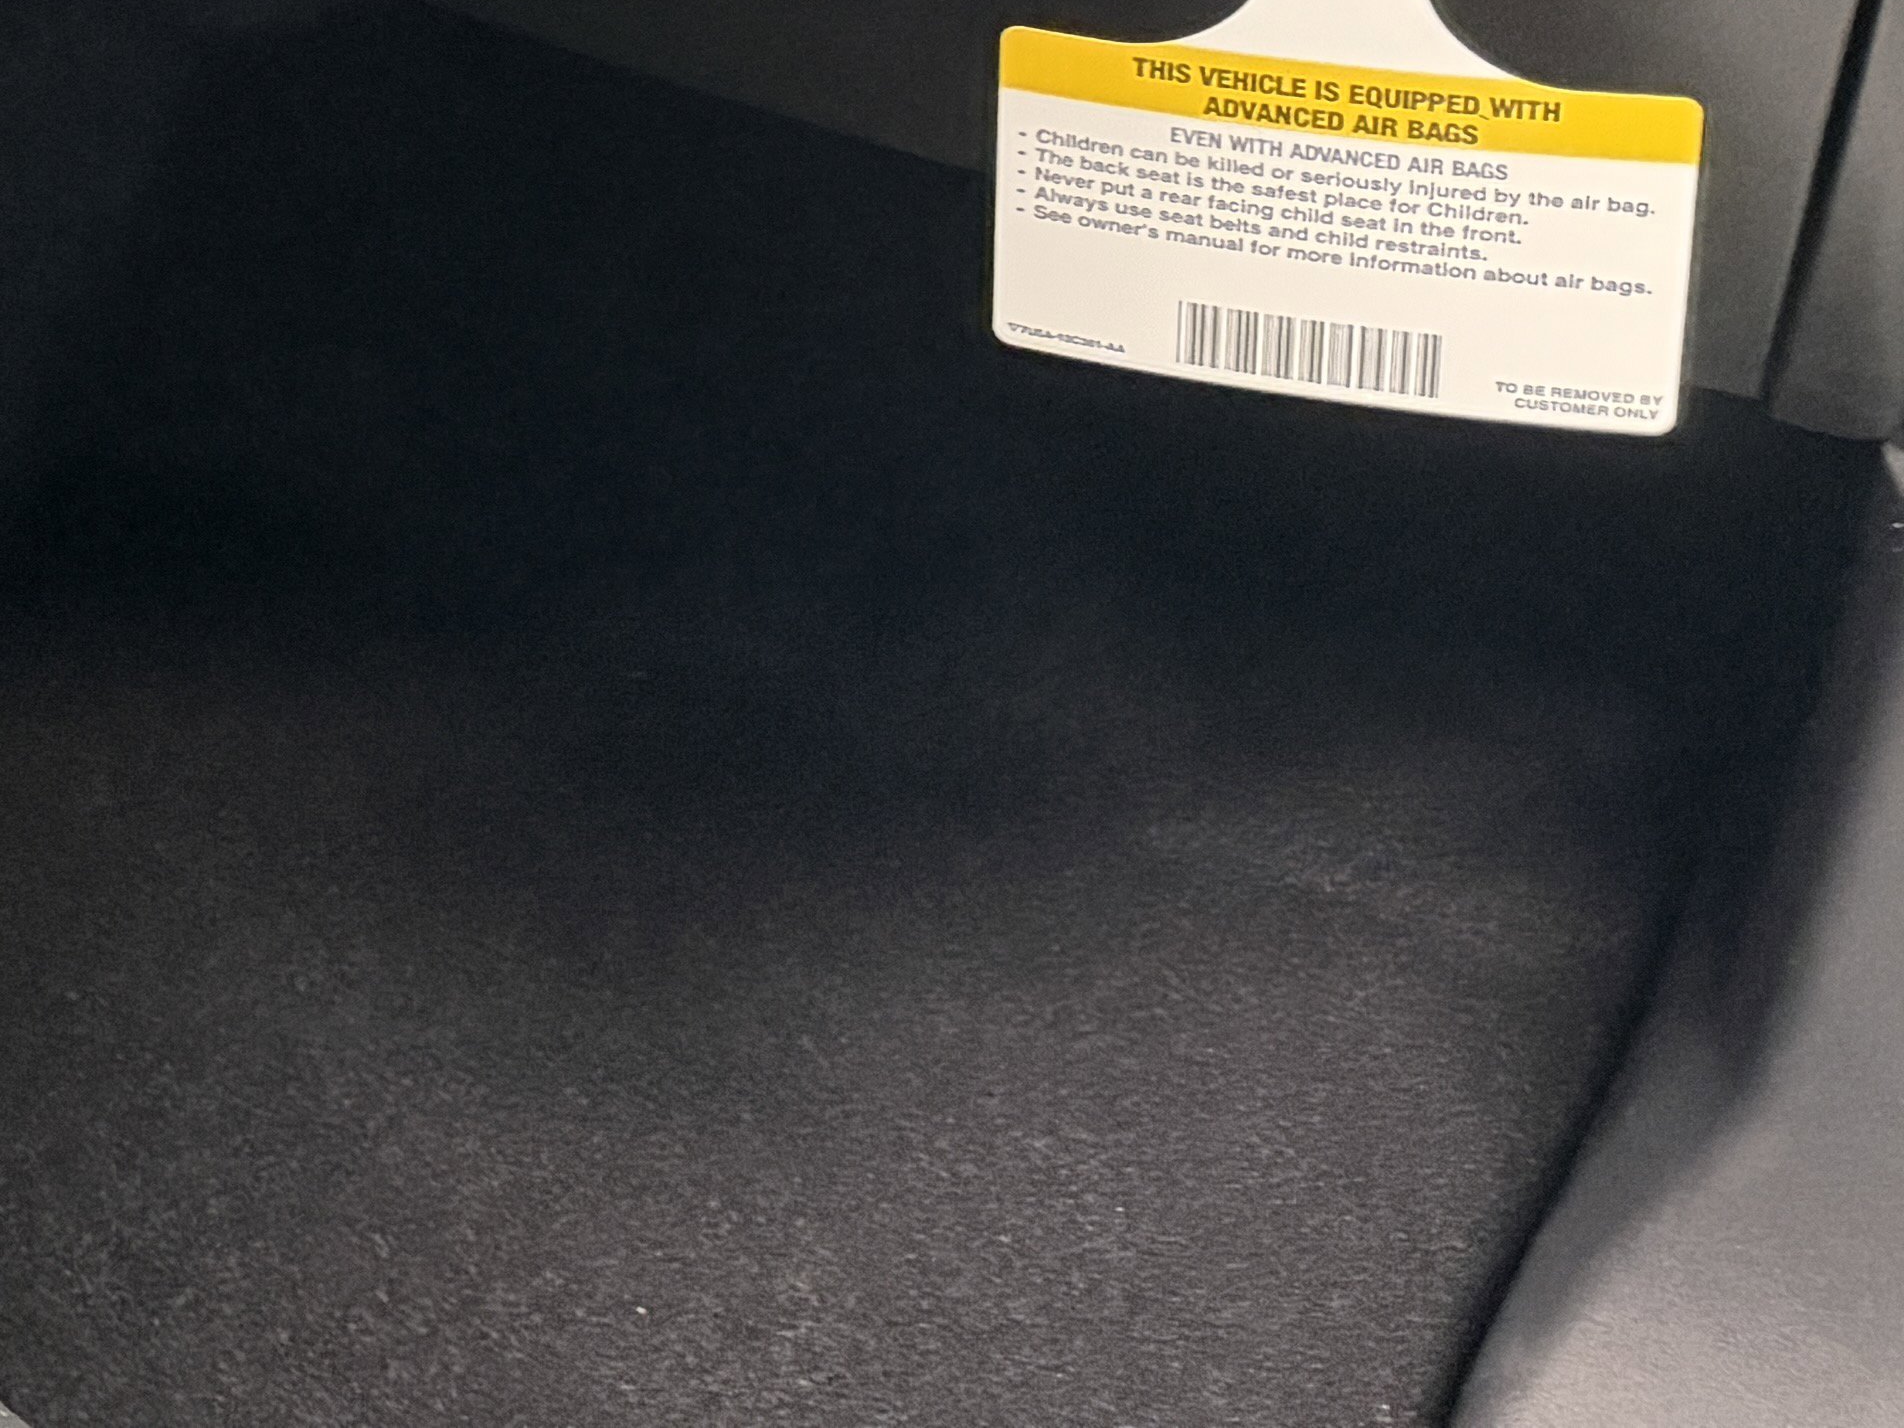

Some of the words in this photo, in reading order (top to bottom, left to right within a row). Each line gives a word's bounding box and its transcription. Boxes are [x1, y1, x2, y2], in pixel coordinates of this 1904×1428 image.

[1133, 55, 1191, 84] THIS
[1199, 65, 1306, 99] VEHICLE
[1315, 79, 1340, 103] IS
[1349, 82, 1481, 116] EQUIPPED
[1489, 95, 1561, 124] WITH
[1202, 96, 1345, 132] ADVANCED
[1352, 113, 1400, 138] AIR
[1407, 118, 1479, 146] BAGS
[1034, 147, 1074, 168] The
[1079, 156, 1130, 177] back
[1136, 166, 1180, 185] seat
[1186, 171, 1204, 189] is
[1210, 175, 1245, 194] the
[1251, 183, 1317, 204] safest
[1323, 192, 1383, 212] place
[1389, 198, 1421, 215] for
[1426, 201, 1529, 225] Children.
[1035, 128, 1125, 157] Children
[1129, 145, 1168, 164] can
[1174, 150, 1200, 168] be
[1207, 155, 1265, 178] killed
[1271, 166, 1293, 181] or
[1300, 169, 1402, 196] seriously
[1494, 187, 1521, 208] by
[1528, 192, 1564, 209] the
[1571, 195, 1600, 212] air
[1607, 197, 1655, 218] bag.
[1170, 125, 1222, 149] EVEN
[1228, 134, 1283, 158] WITH
[1289, 142, 1401, 171] ADVANCED
[1407, 156, 1444, 175] AIR
[1452, 159, 1509, 181] BAGS
[1034, 166, 1095, 189] Never
[1100, 179, 1135, 197] put
[1140, 187, 1154, 200] a
[1159, 191, 1202, 207] rear
[1207, 193, 1274, 221] facing
[1280, 206, 1334, 225] child
[1340, 216, 1387, 231] seat
[1420, 221, 1455, 238] the
[1462, 225, 1522, 245] front.
[1034, 186, 1110, 212] Always
[1115, 203, 1153, 219] use
[1158, 209, 1203, 227] seat
[1209, 214, 1262, 235] belts
[1267, 225, 1309, 242] and
[1314, 231, 1369, 249] child
[1374, 237, 1488, 261] restraints.
[1033, 204, 1072, 224] See
[1077, 213, 1159, 239] owner's
[1165, 228, 1243, 252] manual
[1250, 238, 1281, 256] for
[1286, 247, 1343, 265] more
[1483, 268, 1548, 286] about
[1554, 273, 1584, 290] air
[1590, 276, 1653, 297] bags.
[1495, 380, 1518, 394] TO
[1523, 384, 1546, 397] BE
[1550, 386, 1635, 404] REMOVED
[1639, 393, 1664, 406] BY
[1514, 397, 1609, 417] CUSTOMER
[1613, 406, 1660, 420] ONLY
